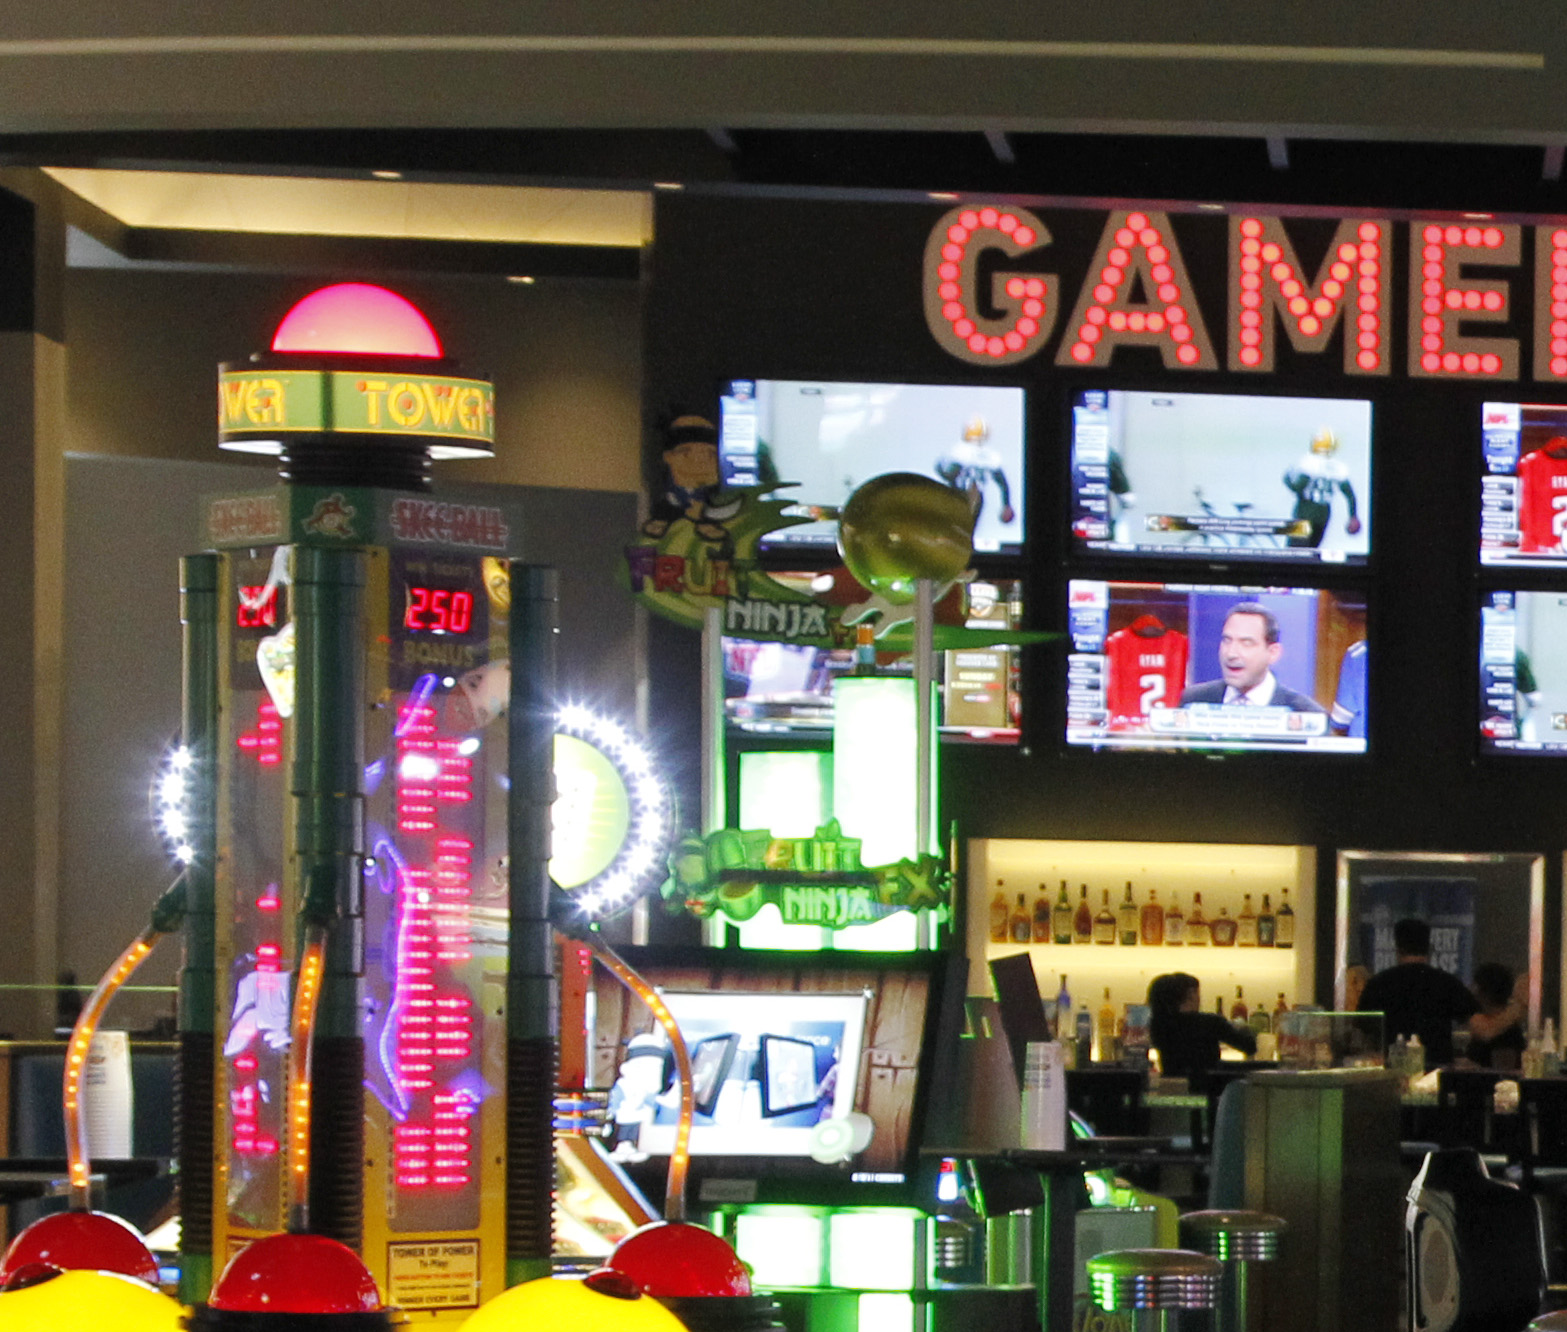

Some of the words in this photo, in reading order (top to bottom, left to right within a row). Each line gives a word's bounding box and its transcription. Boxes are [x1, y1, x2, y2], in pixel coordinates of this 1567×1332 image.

[357, 380, 486, 432] TOWER
[406, 588, 474, 633] 250
[727, 601, 827, 638] NINJA
[1139, 674, 1166, 715] 2
[782, 886, 873, 923] NINJA
